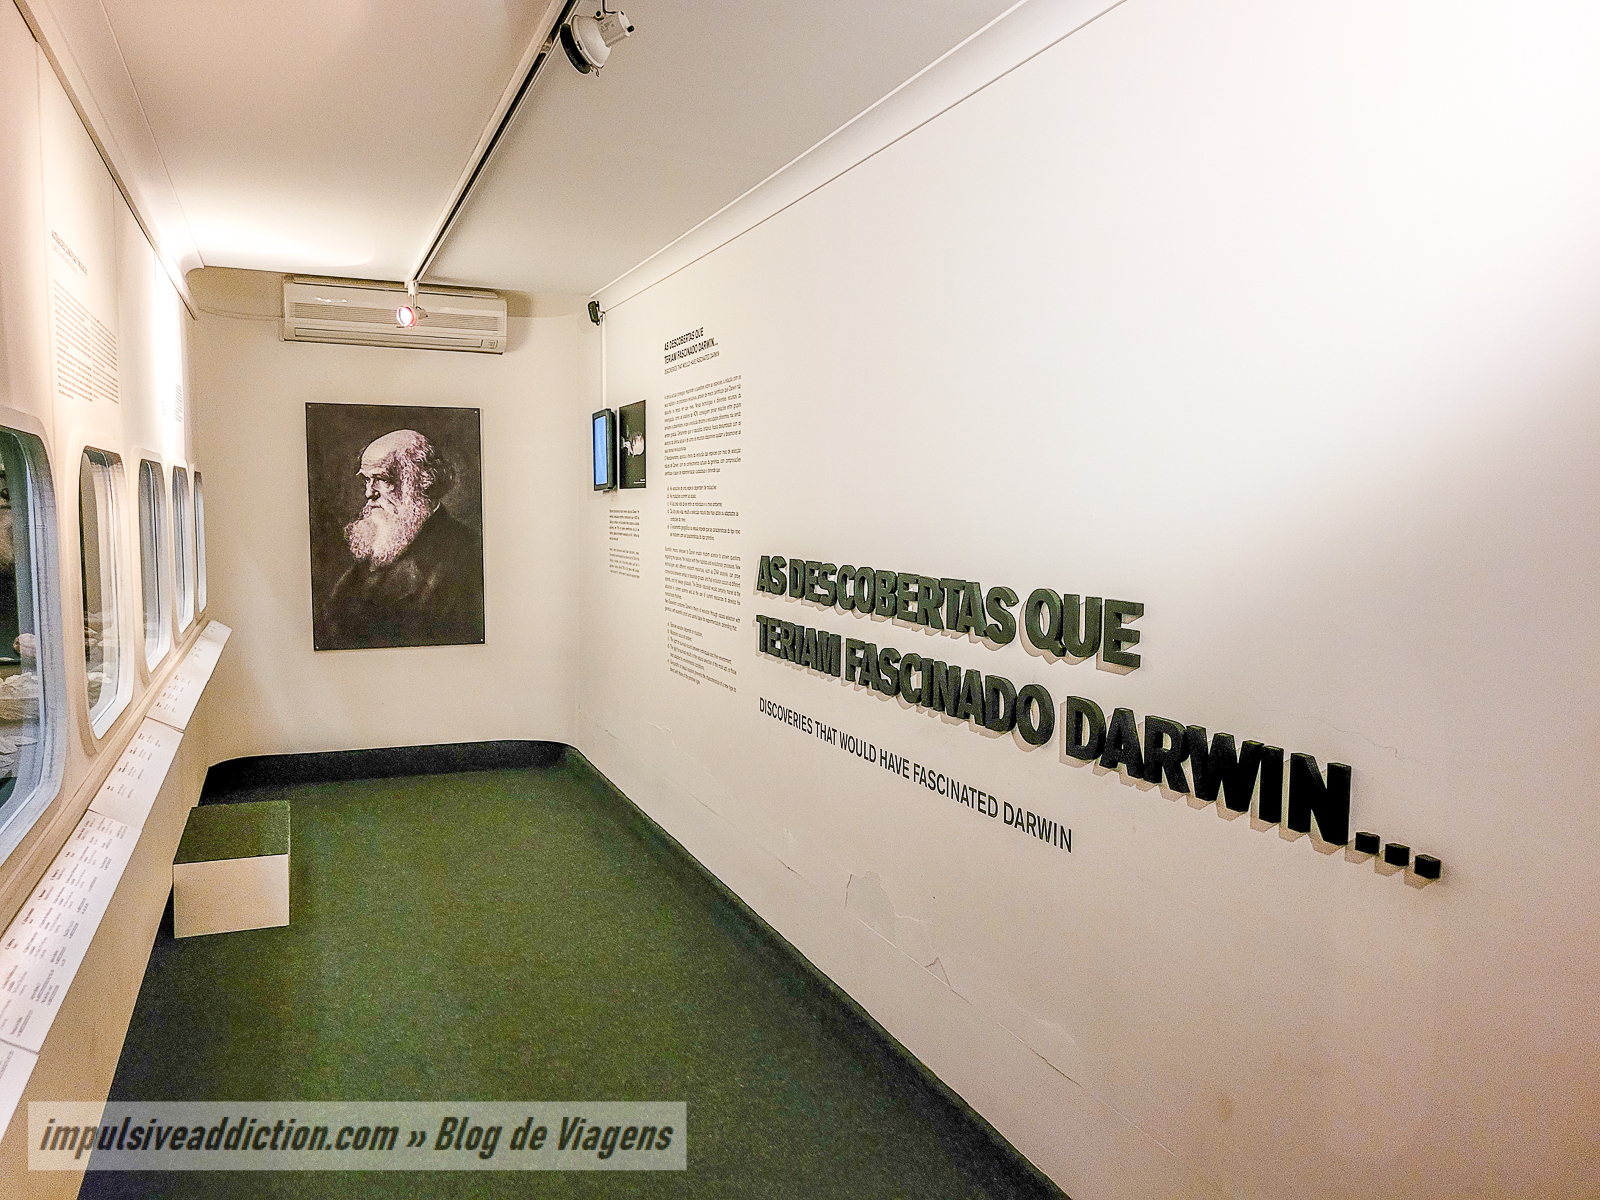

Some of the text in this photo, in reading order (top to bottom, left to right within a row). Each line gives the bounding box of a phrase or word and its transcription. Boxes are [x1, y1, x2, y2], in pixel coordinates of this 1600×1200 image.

[756, 555, 787, 596] AS
[789, 558, 1020, 645] DESCOBERTAS
[1024, 587, 1145, 669] QUE
[756, 614, 842, 678] TERIAM
[845, 637, 1056, 746] FASCINADO
[1065, 695, 1442, 880] DARWIN...
[759, 697, 1072, 854] DISCOVERIES THAT WOULD HAVE FASCINATED DARWIN
